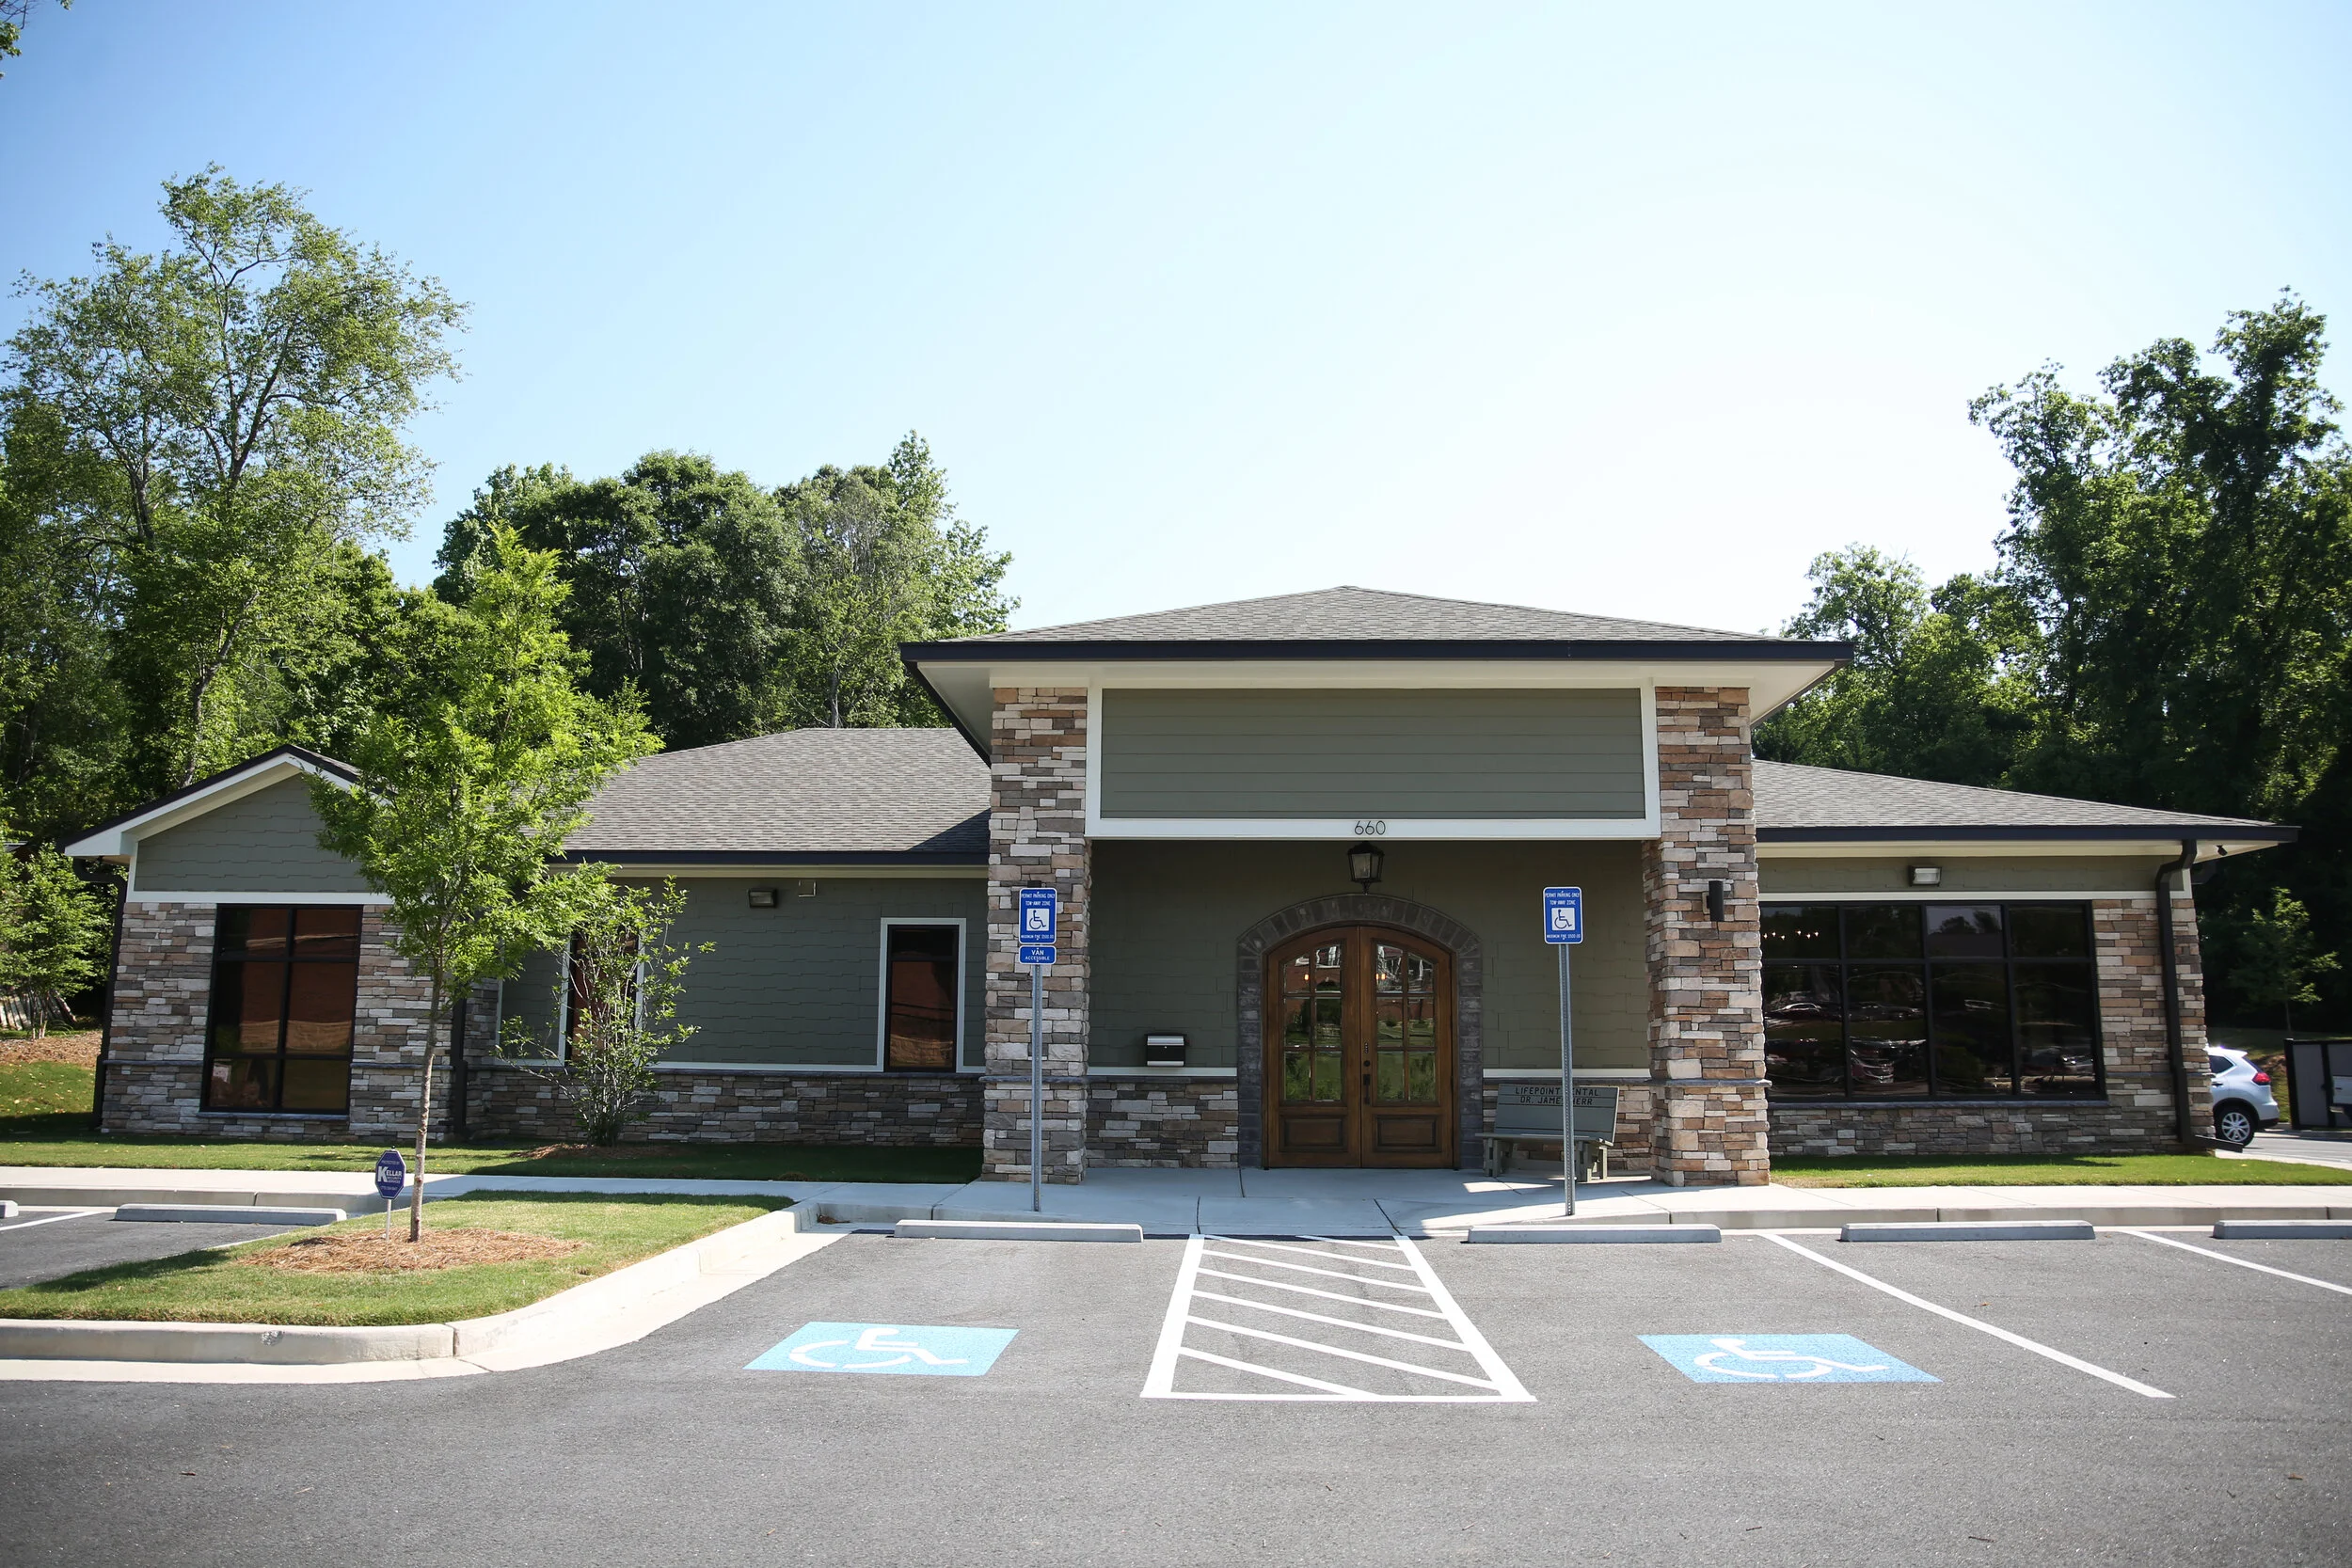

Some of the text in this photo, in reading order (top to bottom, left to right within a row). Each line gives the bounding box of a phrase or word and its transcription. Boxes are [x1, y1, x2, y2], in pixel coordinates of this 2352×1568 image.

[1355, 820, 1386, 835] 660
[1516, 1086, 1561, 1095] LIFEPOINT
[1520, 1096, 1534, 1104] DR.
[1537, 1097, 1564, 1105] JAME
[377, 1166, 403, 1182] KELLAR
